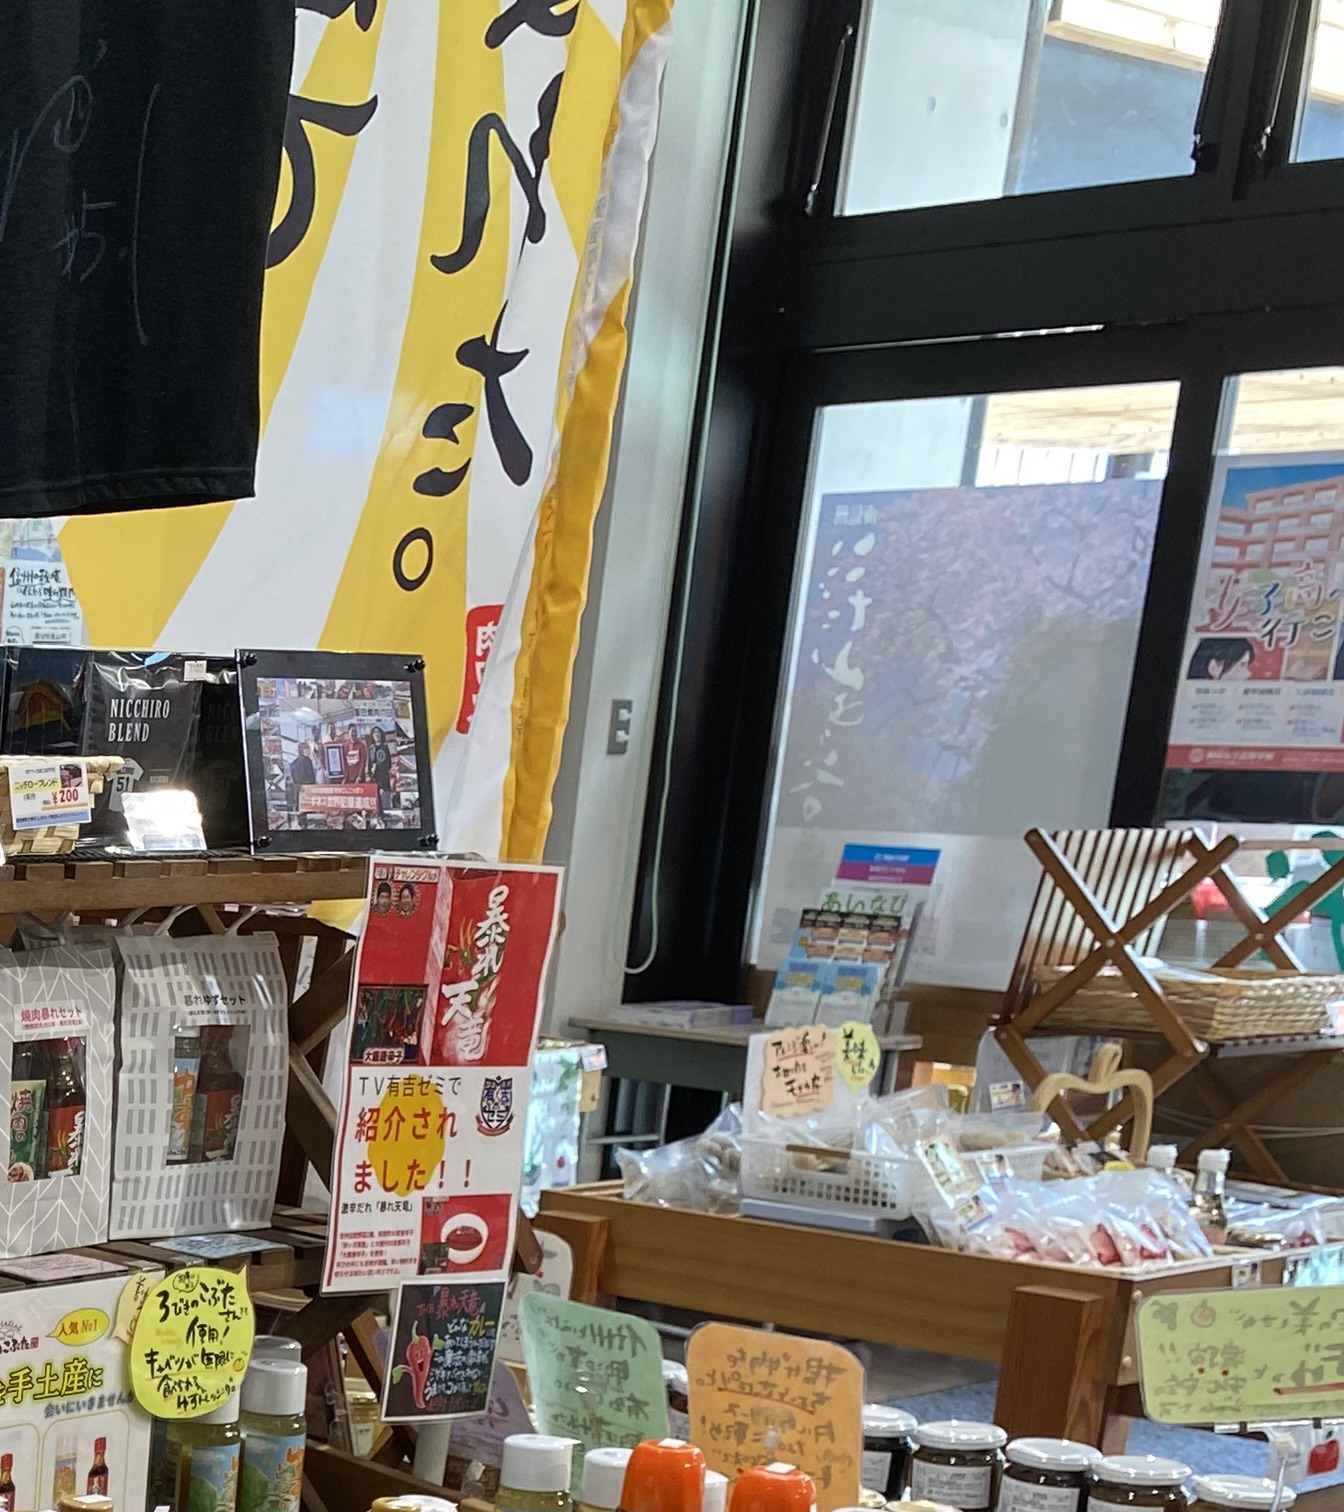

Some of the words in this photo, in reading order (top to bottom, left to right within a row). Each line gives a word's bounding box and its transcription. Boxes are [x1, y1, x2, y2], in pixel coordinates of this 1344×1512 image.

[109, 697, 171, 721] NICCHIRO
[107, 720, 151, 744] BLEND
[116, 775, 130, 793] 51
[51, 788, 79, 807] ¥200
[354, 1105, 458, 1142] 紹介され
[353, 1158, 475, 1196] ました！！
